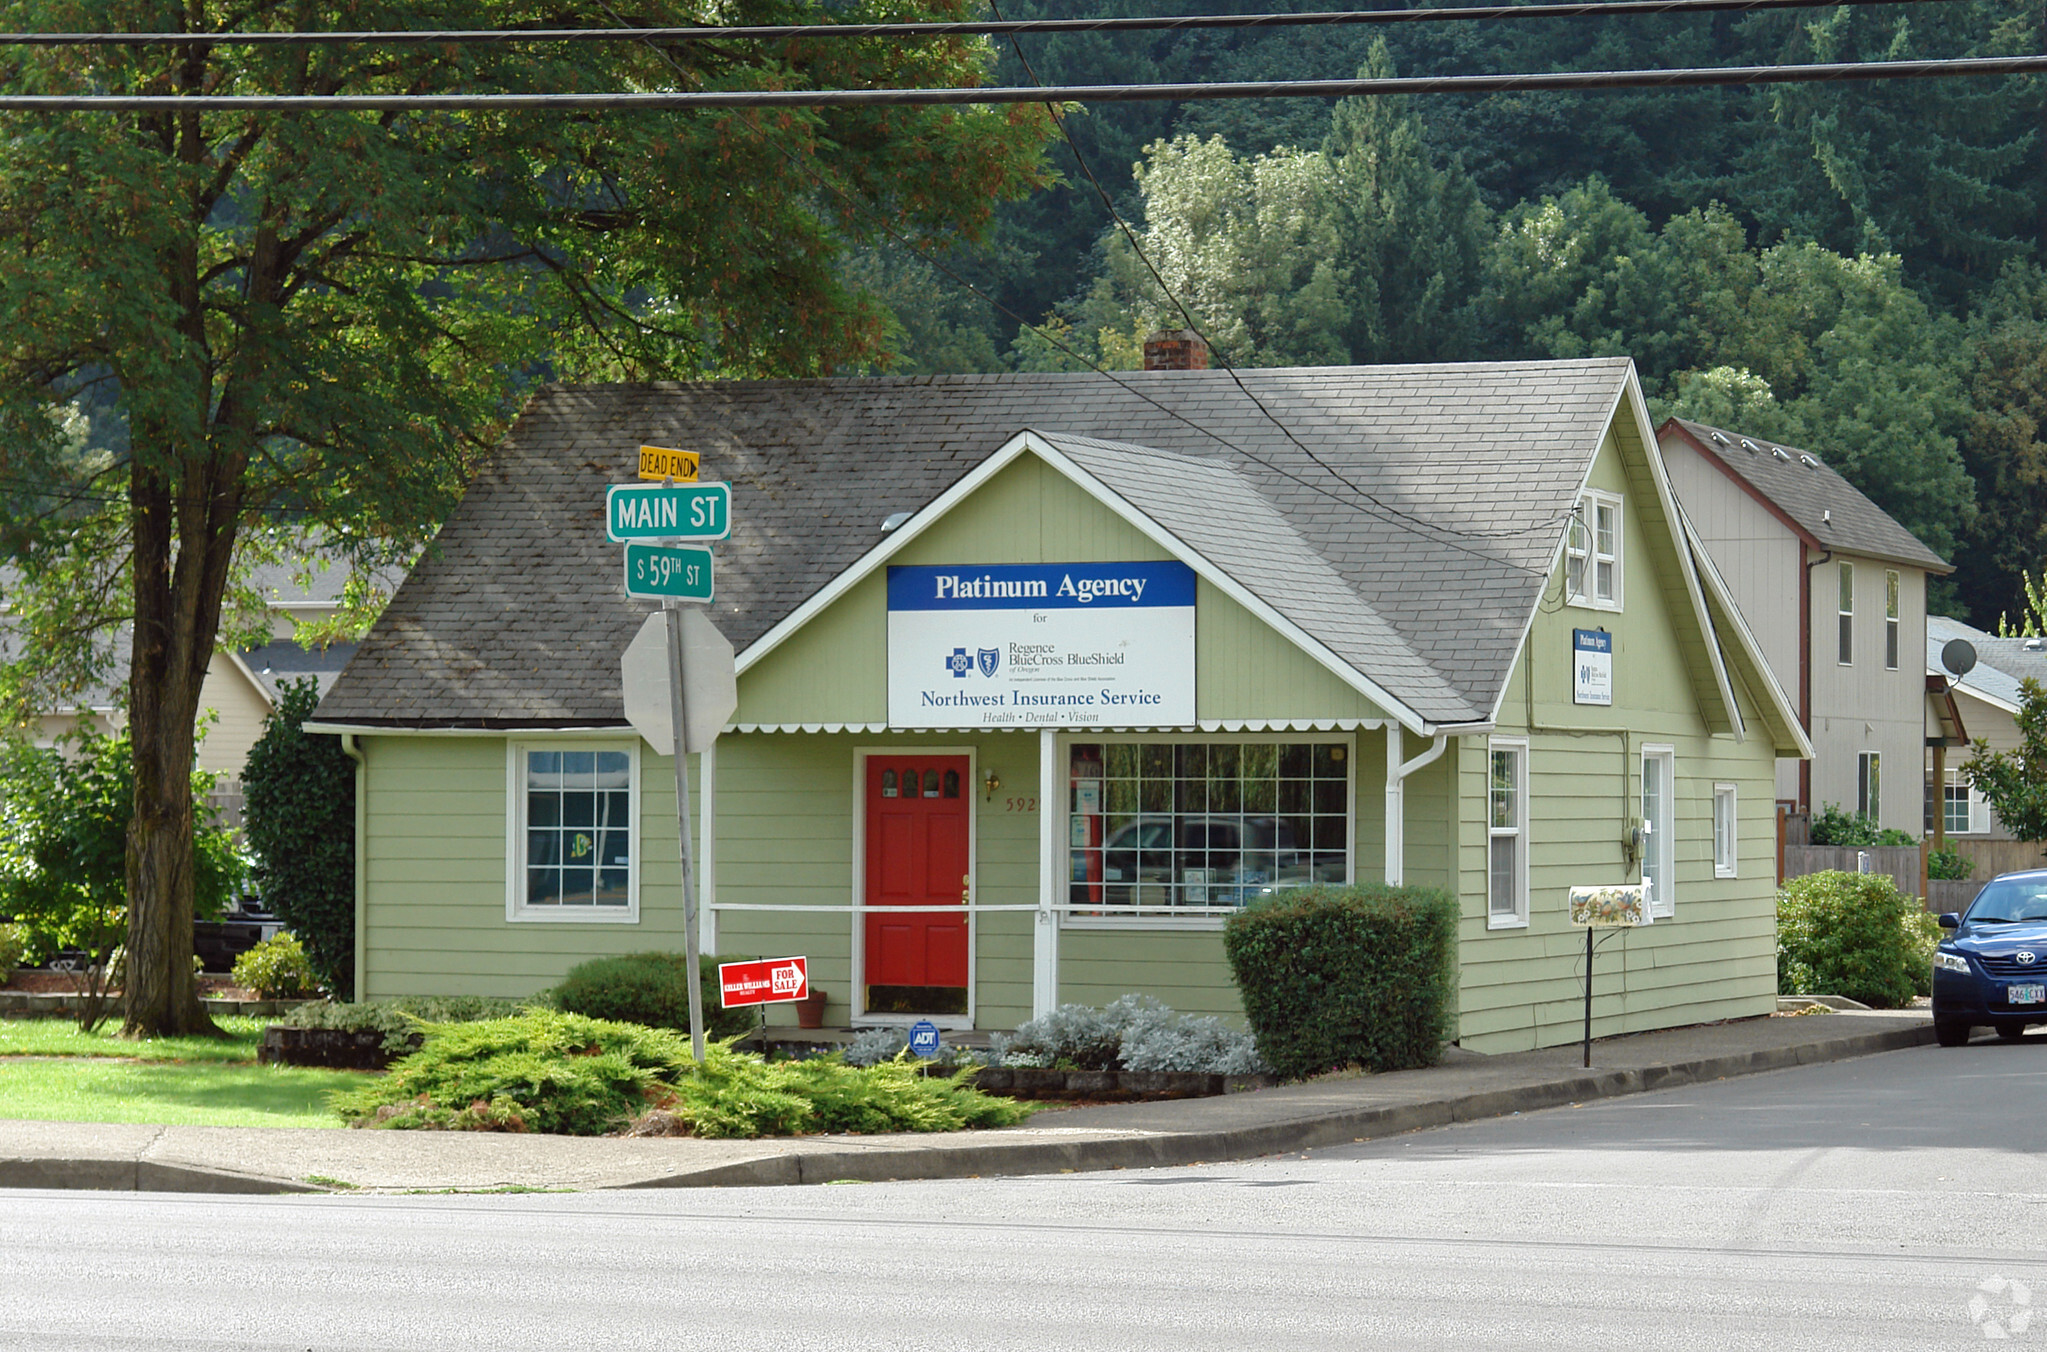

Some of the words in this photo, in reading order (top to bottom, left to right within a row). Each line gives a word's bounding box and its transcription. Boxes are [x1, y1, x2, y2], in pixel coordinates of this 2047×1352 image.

[640, 452, 667, 474] DEAD
[670, 456, 691, 478] END
[618, 497, 677, 529] MAIN
[690, 496, 719, 527] ST
[637, 559, 645, 580] S
[650, 555, 682, 587] 59TH
[686, 565, 700, 586] ST
[935, 575, 1048, 600] Platinum
[1056, 573, 1147, 603] Agency
[1032, 613, 1048, 624] for
[1009, 642, 1055, 657] Regence
[1009, 653, 1064, 666] BlueCross
[1067, 652, 1124, 665] BlueShield
[921, 690, 1005, 707] Northwest
[1012, 689, 1095, 706] Insurance
[1101, 688, 1161, 706] Service
[982, 712, 1015, 723] Health
[1025, 711, 1058, 723] Dental
[1067, 711, 1099, 723] Vision
[1006, 797, 1040, 812] 592
[776, 969, 794, 980] FOR
[774, 980, 798, 991] SALE
[2009, 990, 2024, 1000] 546
[2029, 989, 2045, 999] CXX
[914, 1032, 935, 1045] ADT
